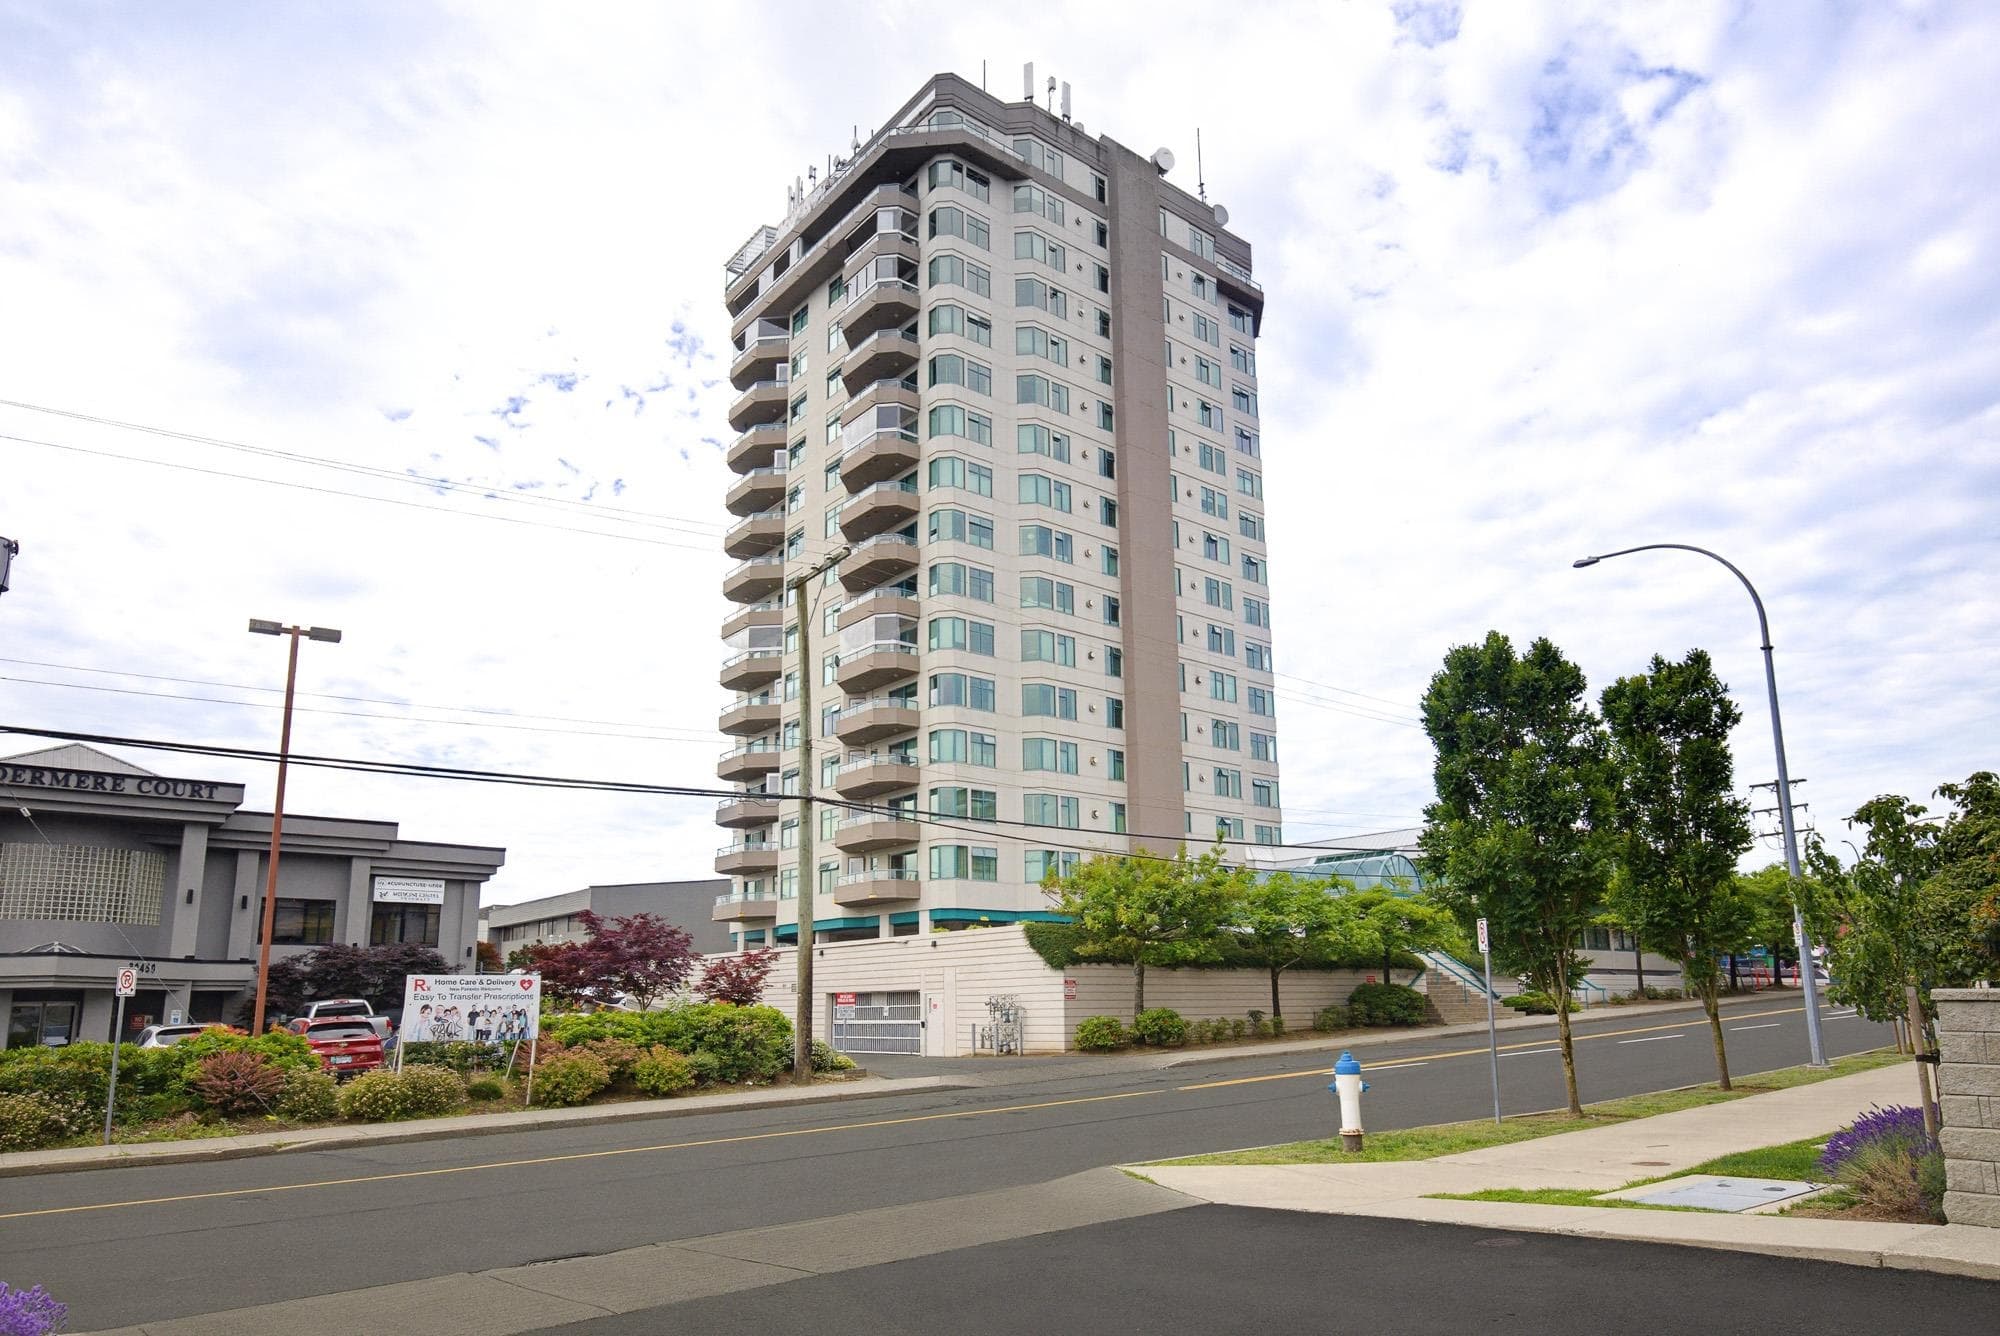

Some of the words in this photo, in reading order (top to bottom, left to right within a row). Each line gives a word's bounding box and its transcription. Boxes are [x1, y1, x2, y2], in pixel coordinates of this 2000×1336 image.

[137, 779, 218, 799] COURT
[486, 979, 516, 987] Delivery
[413, 993, 435, 1002] Easy
[437, 993, 447, 1001] To
[450, 992, 482, 1001] Transfer
[484, 992, 534, 1001] Prescriptions
